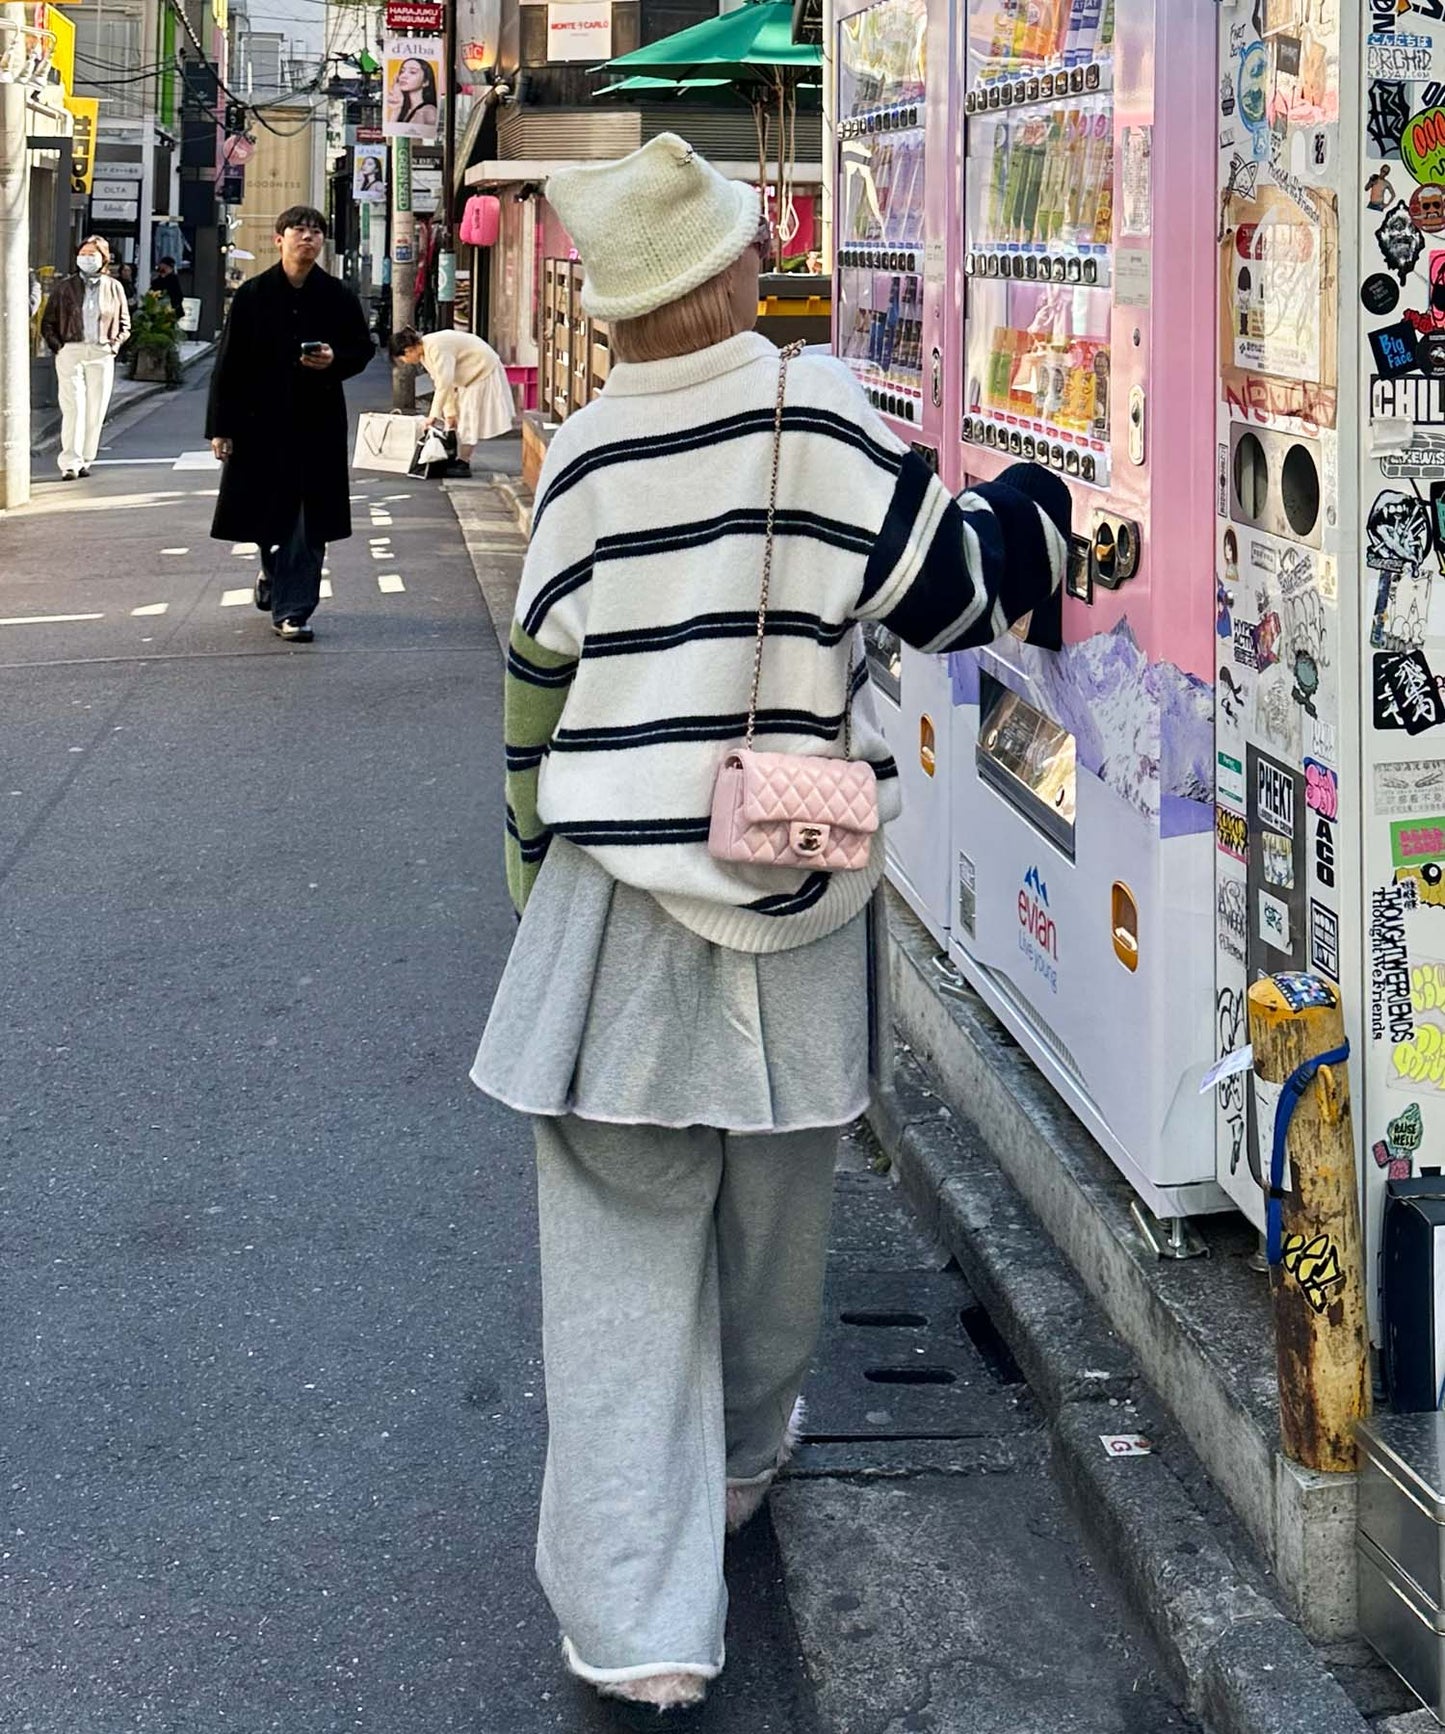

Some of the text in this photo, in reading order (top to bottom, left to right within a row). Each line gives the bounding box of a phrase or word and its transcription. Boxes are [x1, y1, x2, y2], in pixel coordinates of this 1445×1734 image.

[389, 7, 438, 16] HARAJUKU
[391, 16, 436, 24] JINGUMAE
[551, 21, 609, 30] MONTE CARLO
[1370, 35, 1430, 47] こんにちは
[392, 42, 434, 56] d'Alba
[1379, 334, 1405, 355] Big
[1387, 352, 1414, 369] Face
[1259, 761, 1292, 823] PHEKT
[1018, 889, 1058, 961] evian
